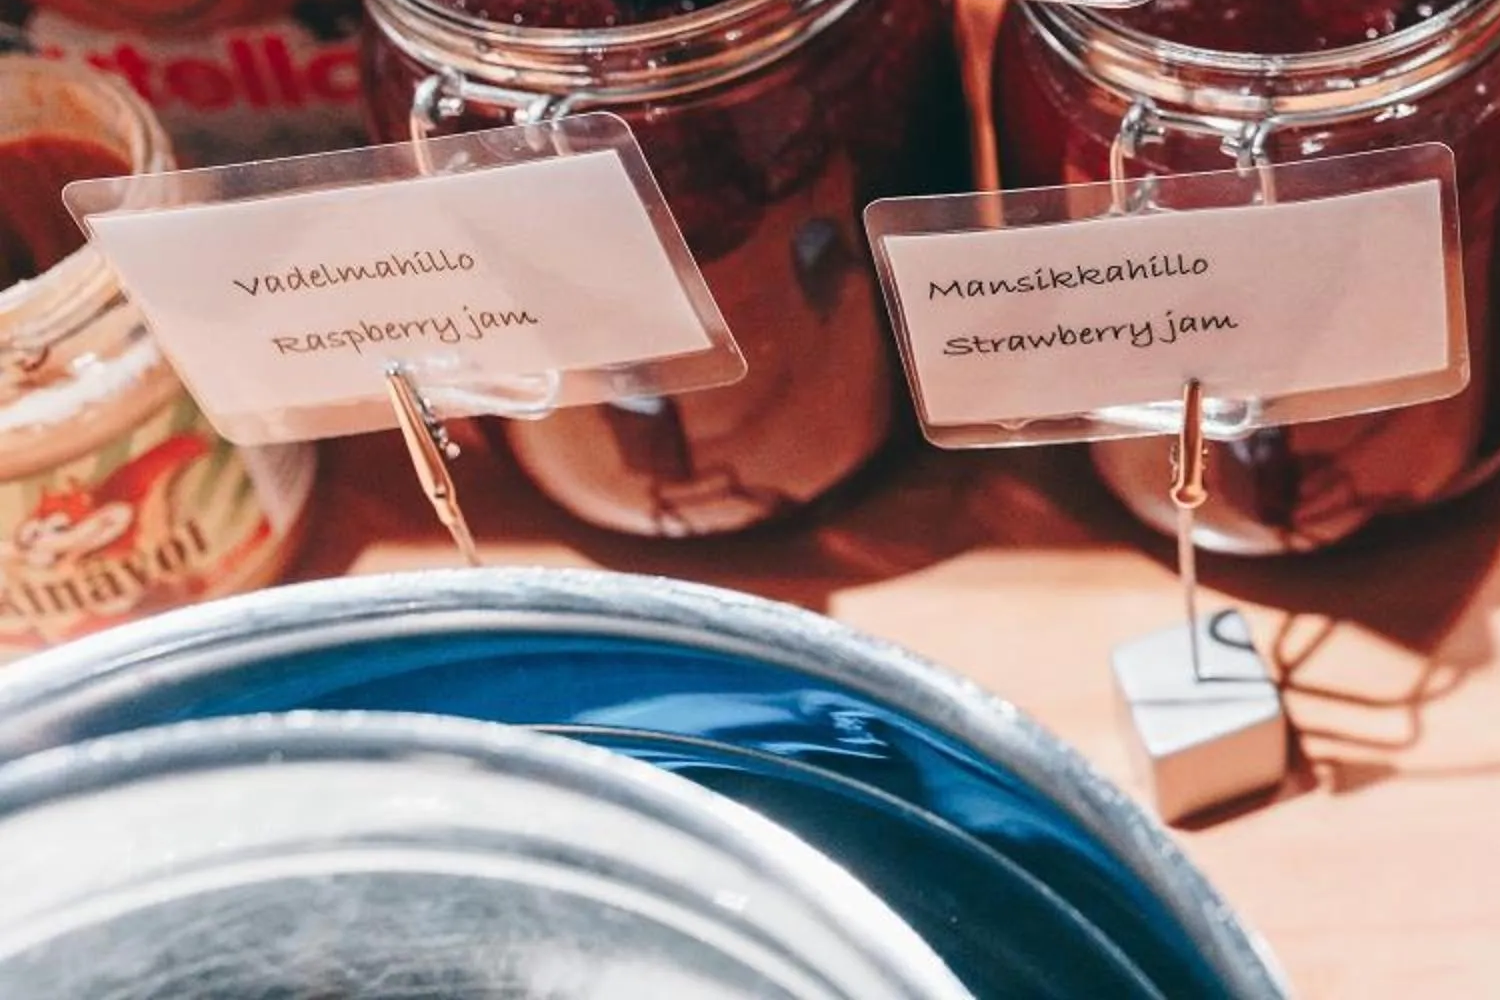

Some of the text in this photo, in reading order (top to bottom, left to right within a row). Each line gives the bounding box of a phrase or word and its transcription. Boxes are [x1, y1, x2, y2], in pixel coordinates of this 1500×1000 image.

[232, 249, 475, 297] Vadelmahillo
[928, 253, 1210, 300] Mansikkahillo
[270, 304, 539, 355] Raspberry jam
[942, 309, 1239, 356] Strawberry jam
